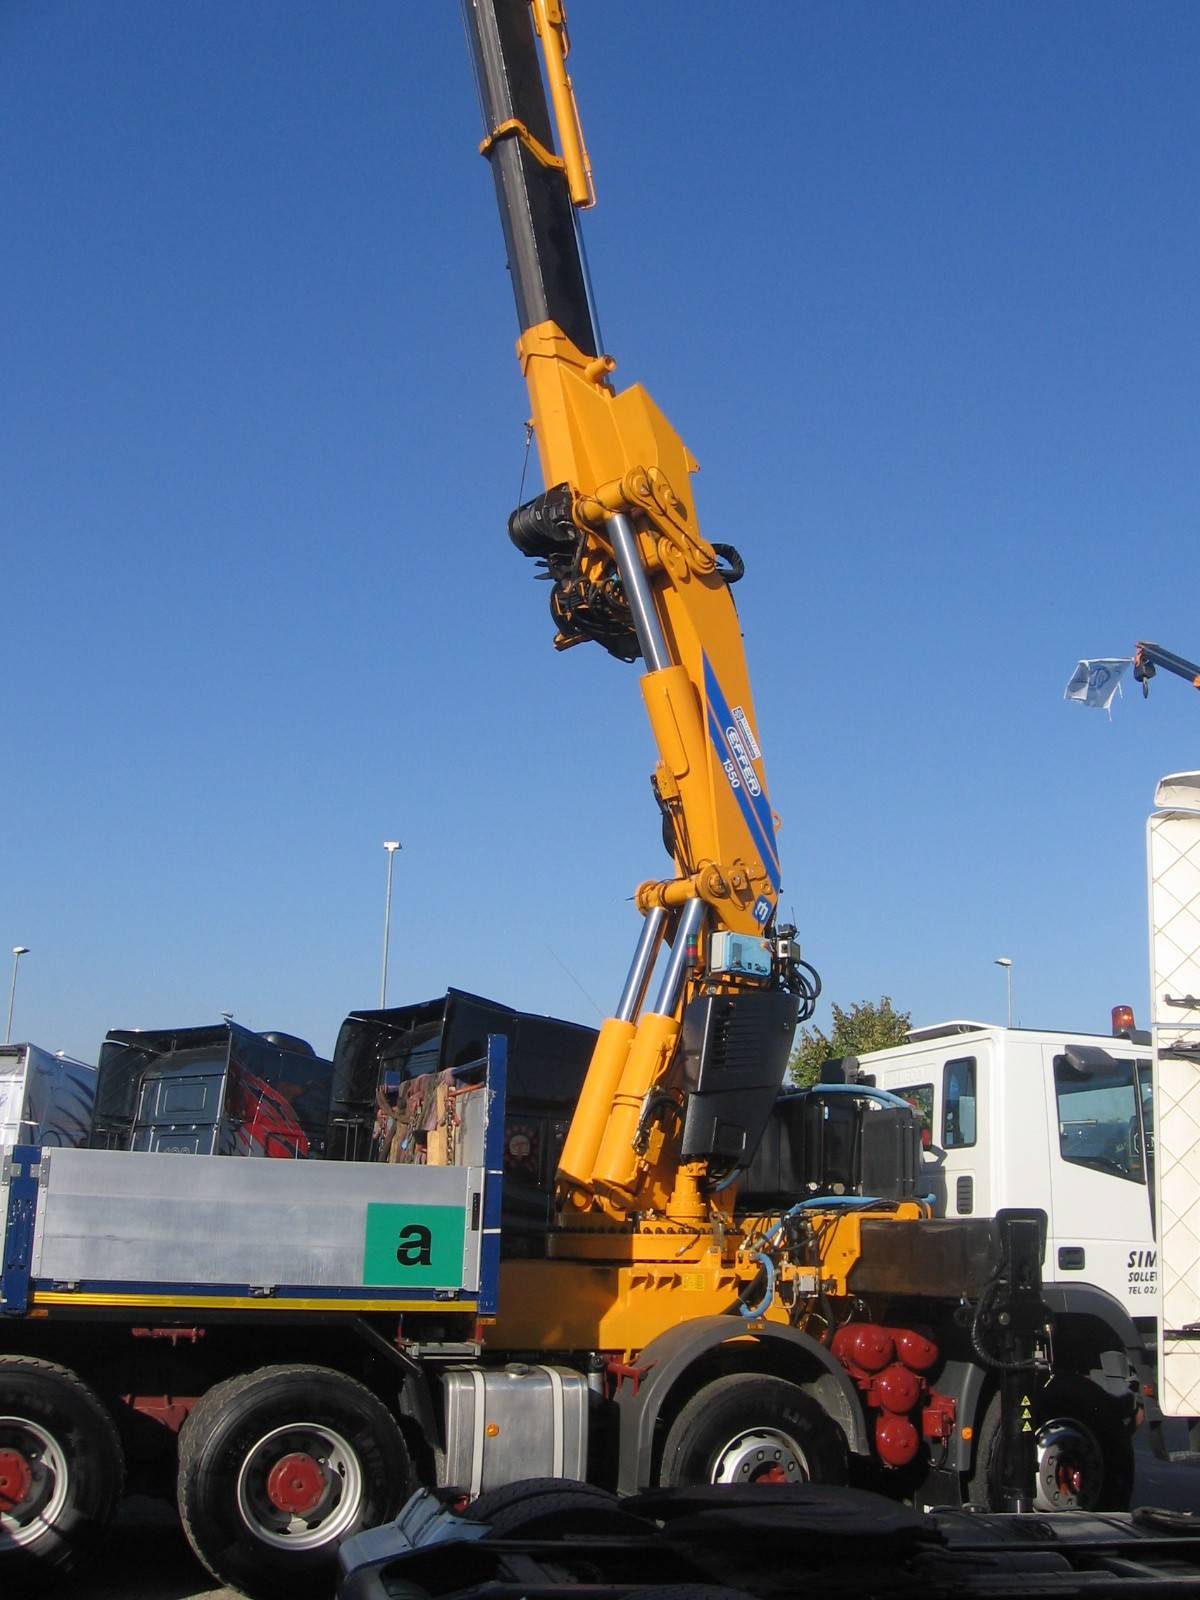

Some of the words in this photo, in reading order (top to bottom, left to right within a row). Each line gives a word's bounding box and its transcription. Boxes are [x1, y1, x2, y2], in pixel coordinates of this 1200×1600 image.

[723, 759, 740, 788] 1350
[728, 729, 760, 793] EFFER
[397, 1224, 432, 1266] a
[1128, 1286, 1142, 1295] TEL
